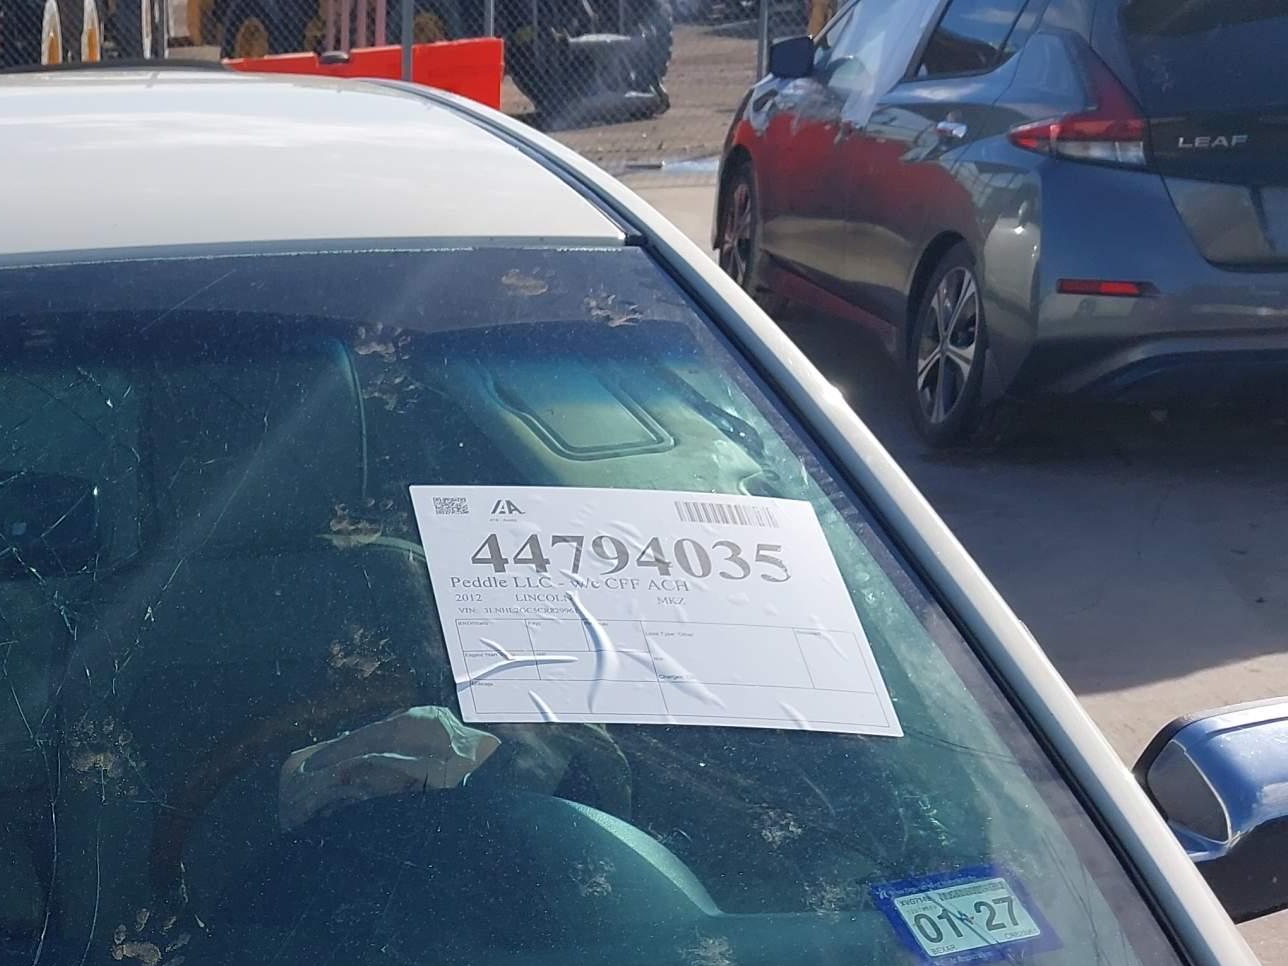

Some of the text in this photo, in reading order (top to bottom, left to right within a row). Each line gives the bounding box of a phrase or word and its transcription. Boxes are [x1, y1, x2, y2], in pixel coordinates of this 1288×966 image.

[1178, 135, 1249, 148] LEAF
[471, 533, 792, 583] 44794035
[450, 576, 509, 589] Peddle
[513, 576, 553, 589] LLC
[605, 577, 640, 590] CFF
[648, 579, 689, 592] ACH
[455, 593, 483, 602] 2012
[914, 896, 1019, 943] 01 27
